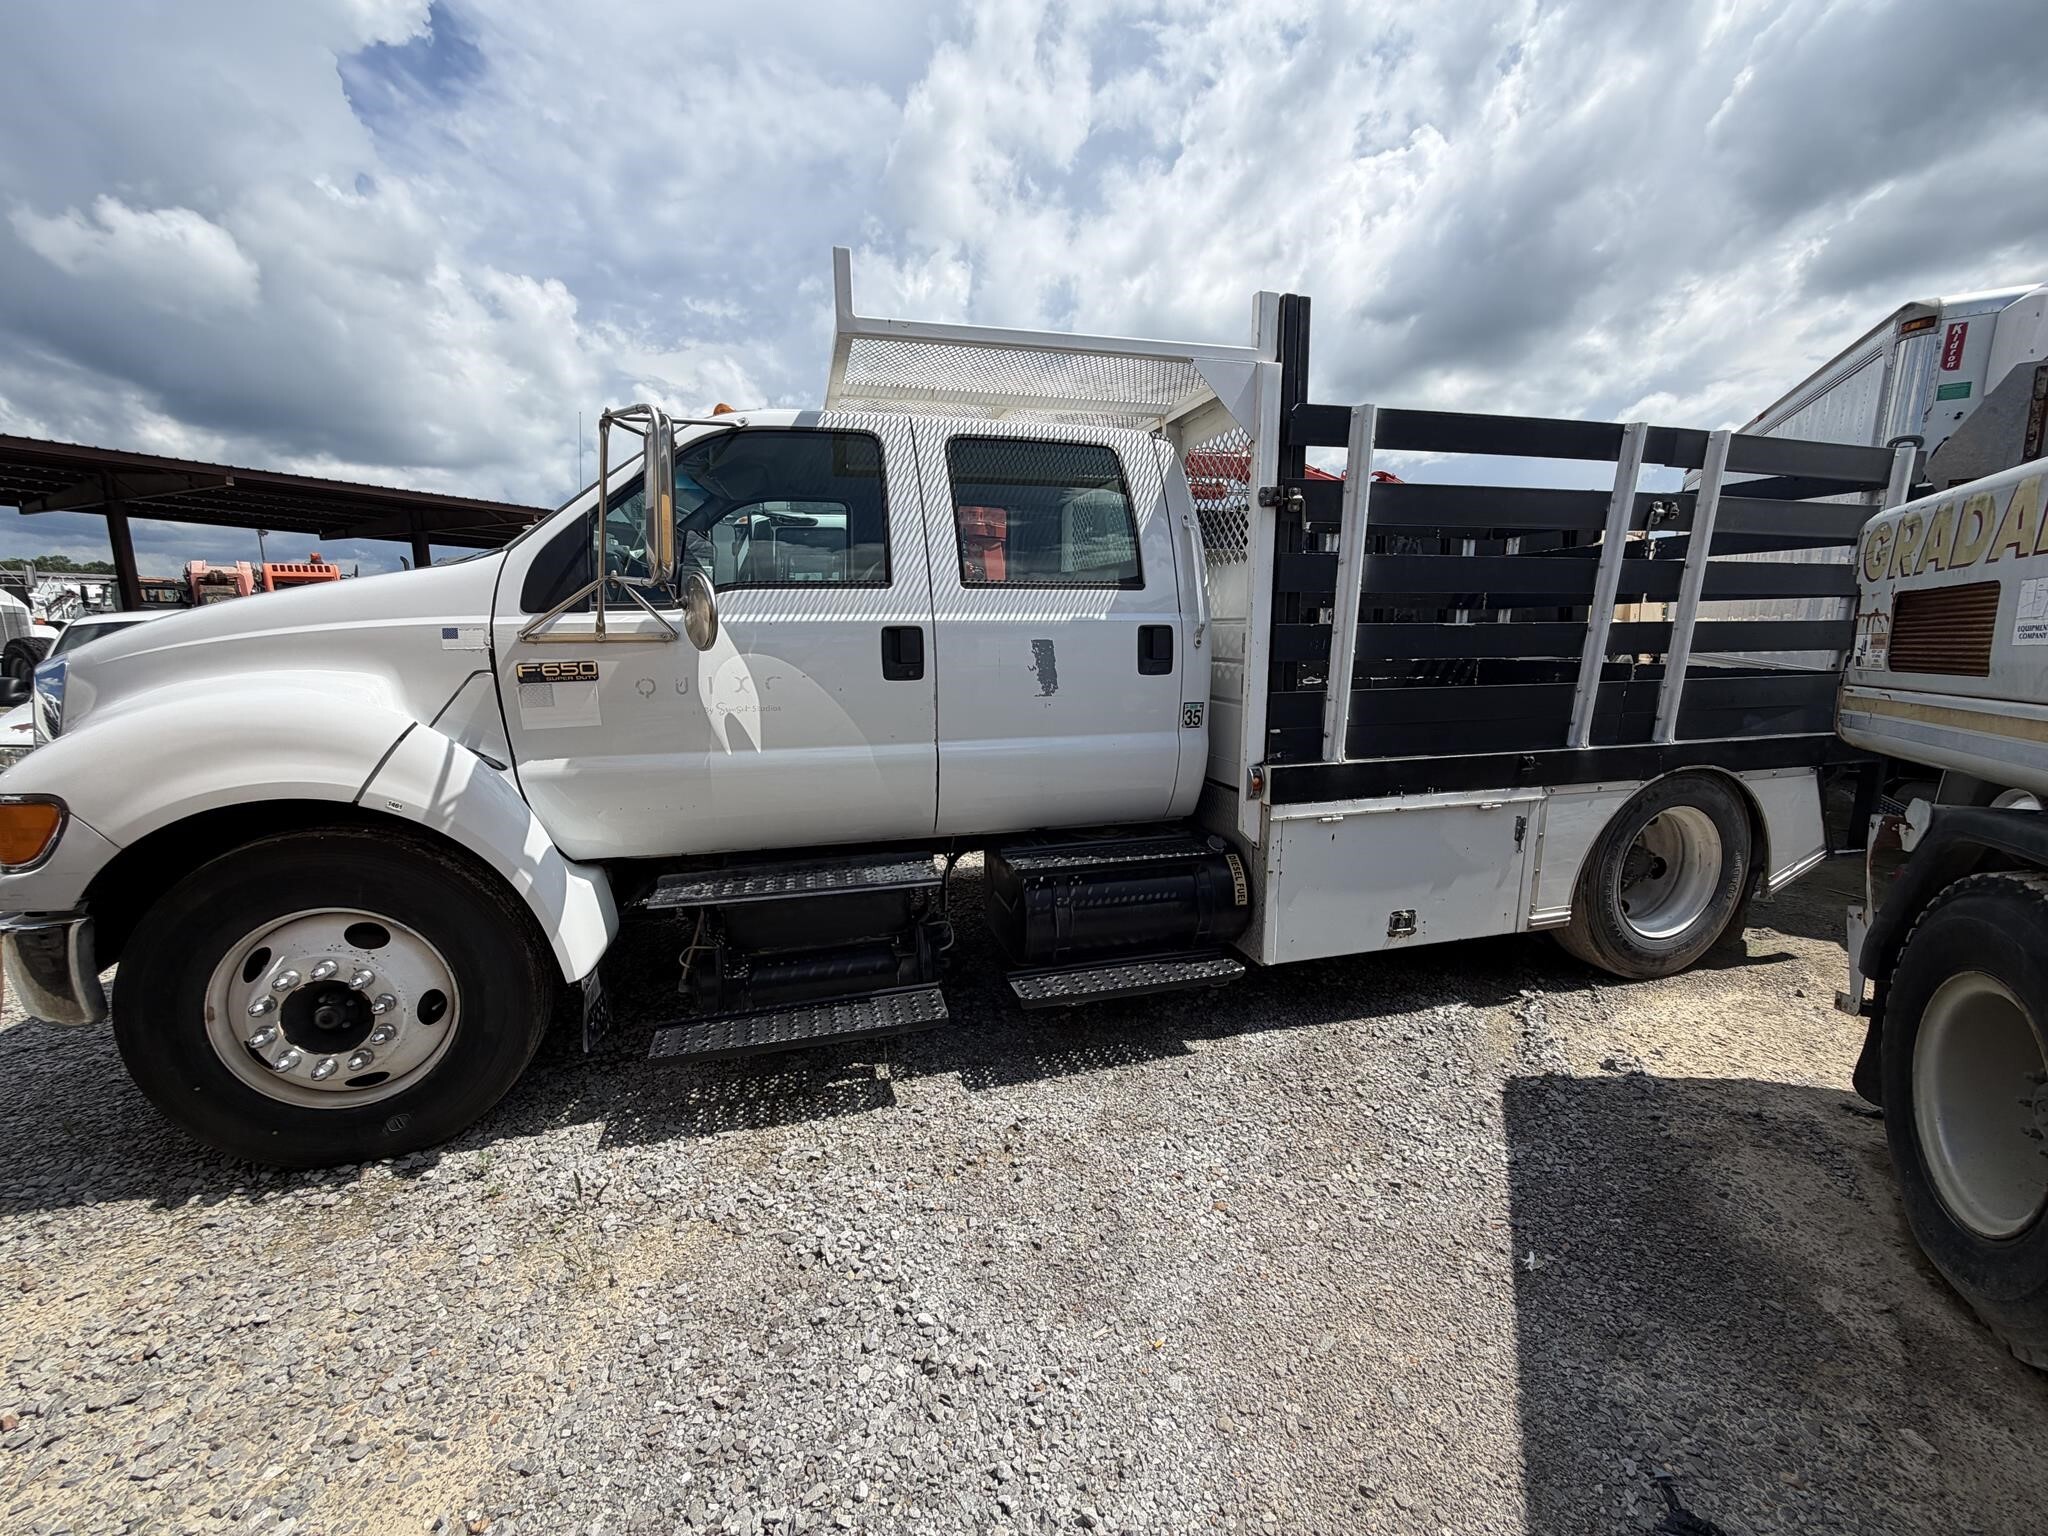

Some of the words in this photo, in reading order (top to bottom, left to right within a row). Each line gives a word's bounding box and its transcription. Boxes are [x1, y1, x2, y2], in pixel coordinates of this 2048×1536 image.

[1946, 323, 1963, 368] Kidron
[1864, 474, 2048, 583] GRADA
[2018, 632, 2047, 640] COMPANY
[1184, 709, 1201, 726] 35
[1227, 855, 1242, 882] DIESEL
[1236, 883, 1246, 905] FUEL
